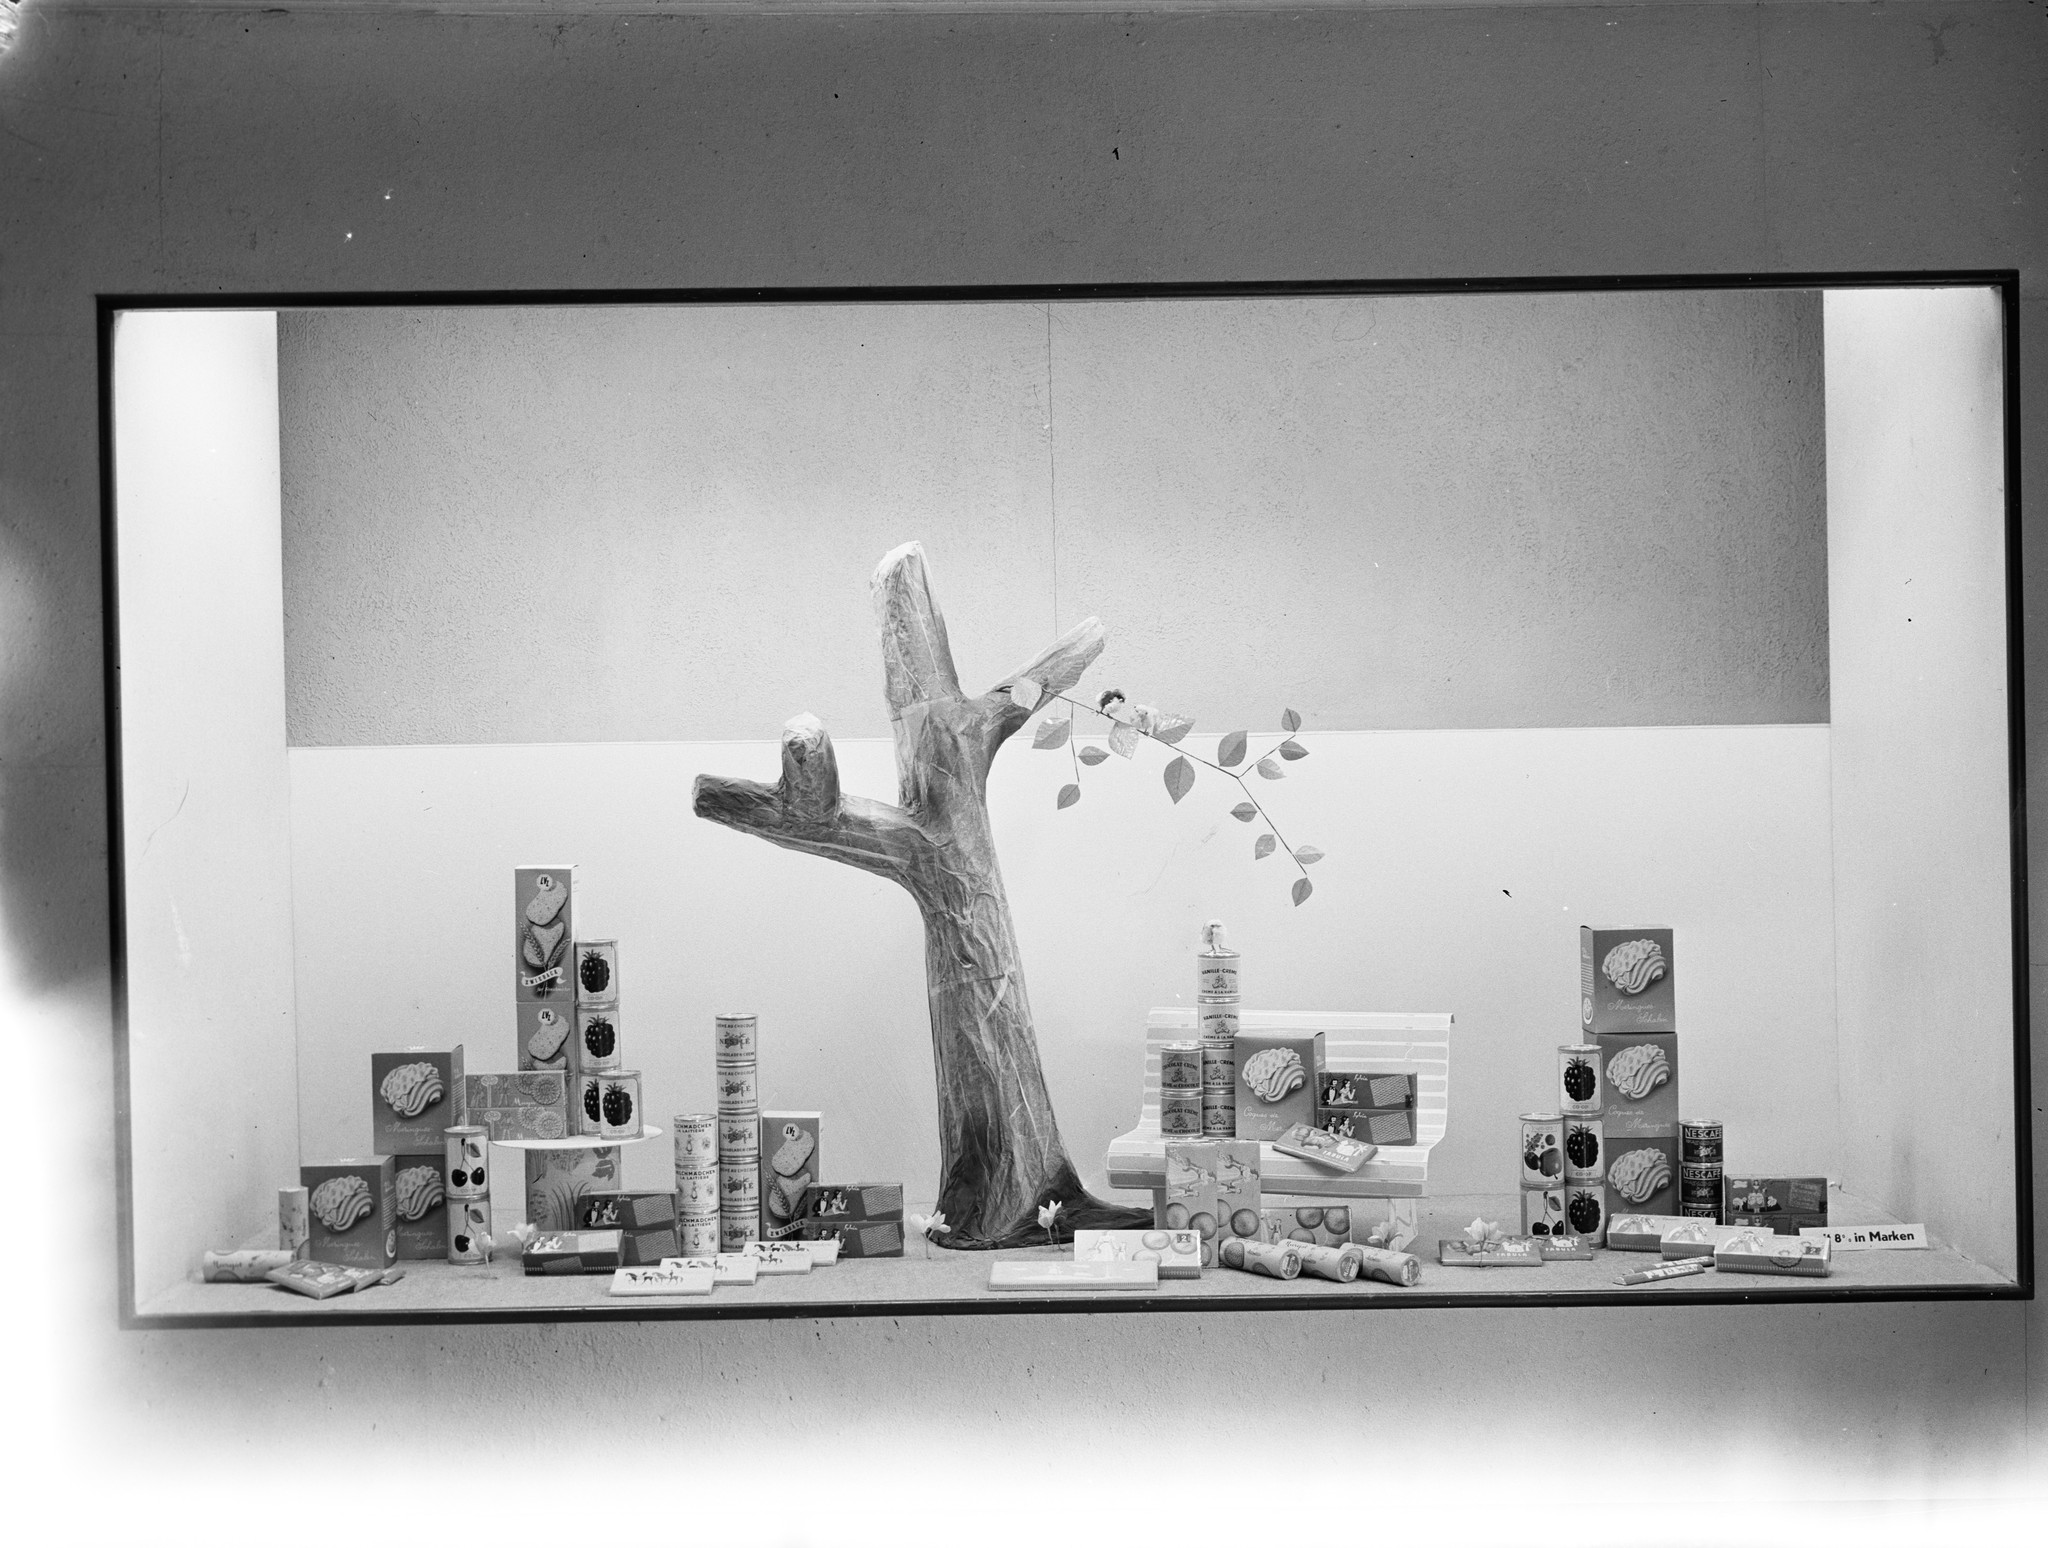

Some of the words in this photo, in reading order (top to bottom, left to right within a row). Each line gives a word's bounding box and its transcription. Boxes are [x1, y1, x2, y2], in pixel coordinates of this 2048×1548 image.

[525, 969, 558, 985] ZWIEBACK
[1322, 1150, 1350, 1162] TABULA
[771, 1220, 804, 1237] ZWIEBACK
[1854, 1232, 1865, 1243] in
[1869, 1231, 1915, 1242] Marken
